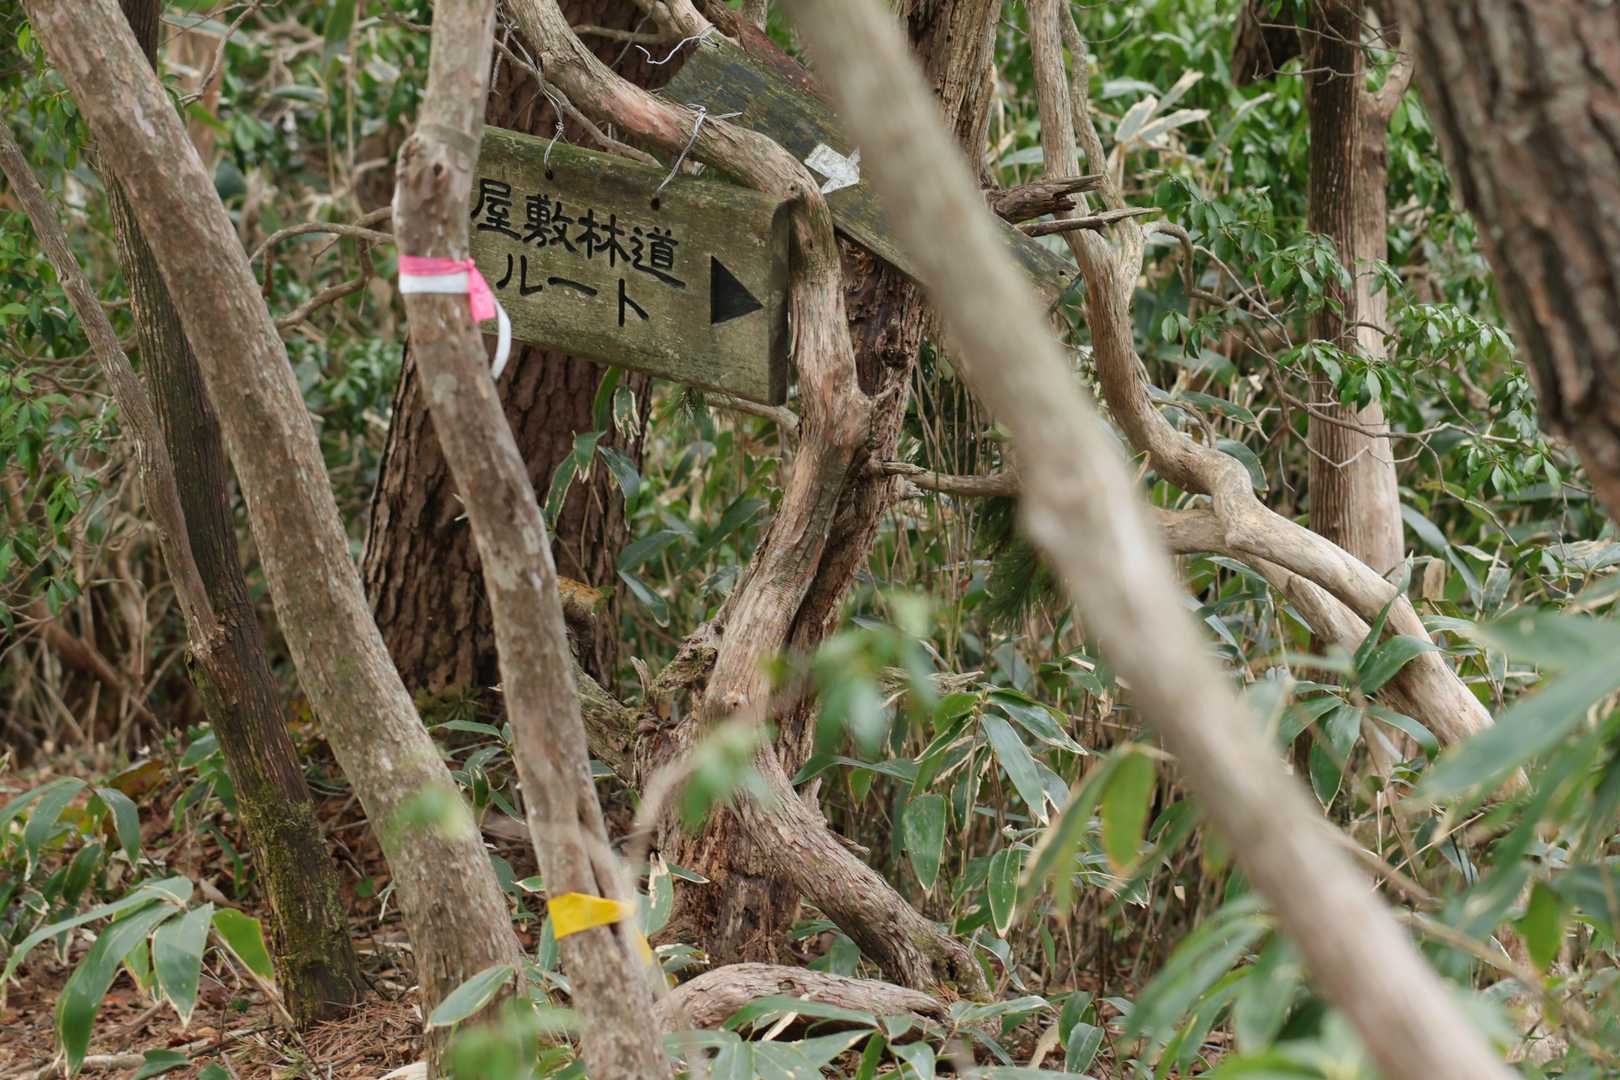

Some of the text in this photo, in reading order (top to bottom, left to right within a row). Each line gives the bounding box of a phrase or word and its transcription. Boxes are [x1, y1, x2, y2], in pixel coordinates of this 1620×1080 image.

[470, 178, 687, 290] 屋敷林道
[496, 253, 649, 327] ルート
